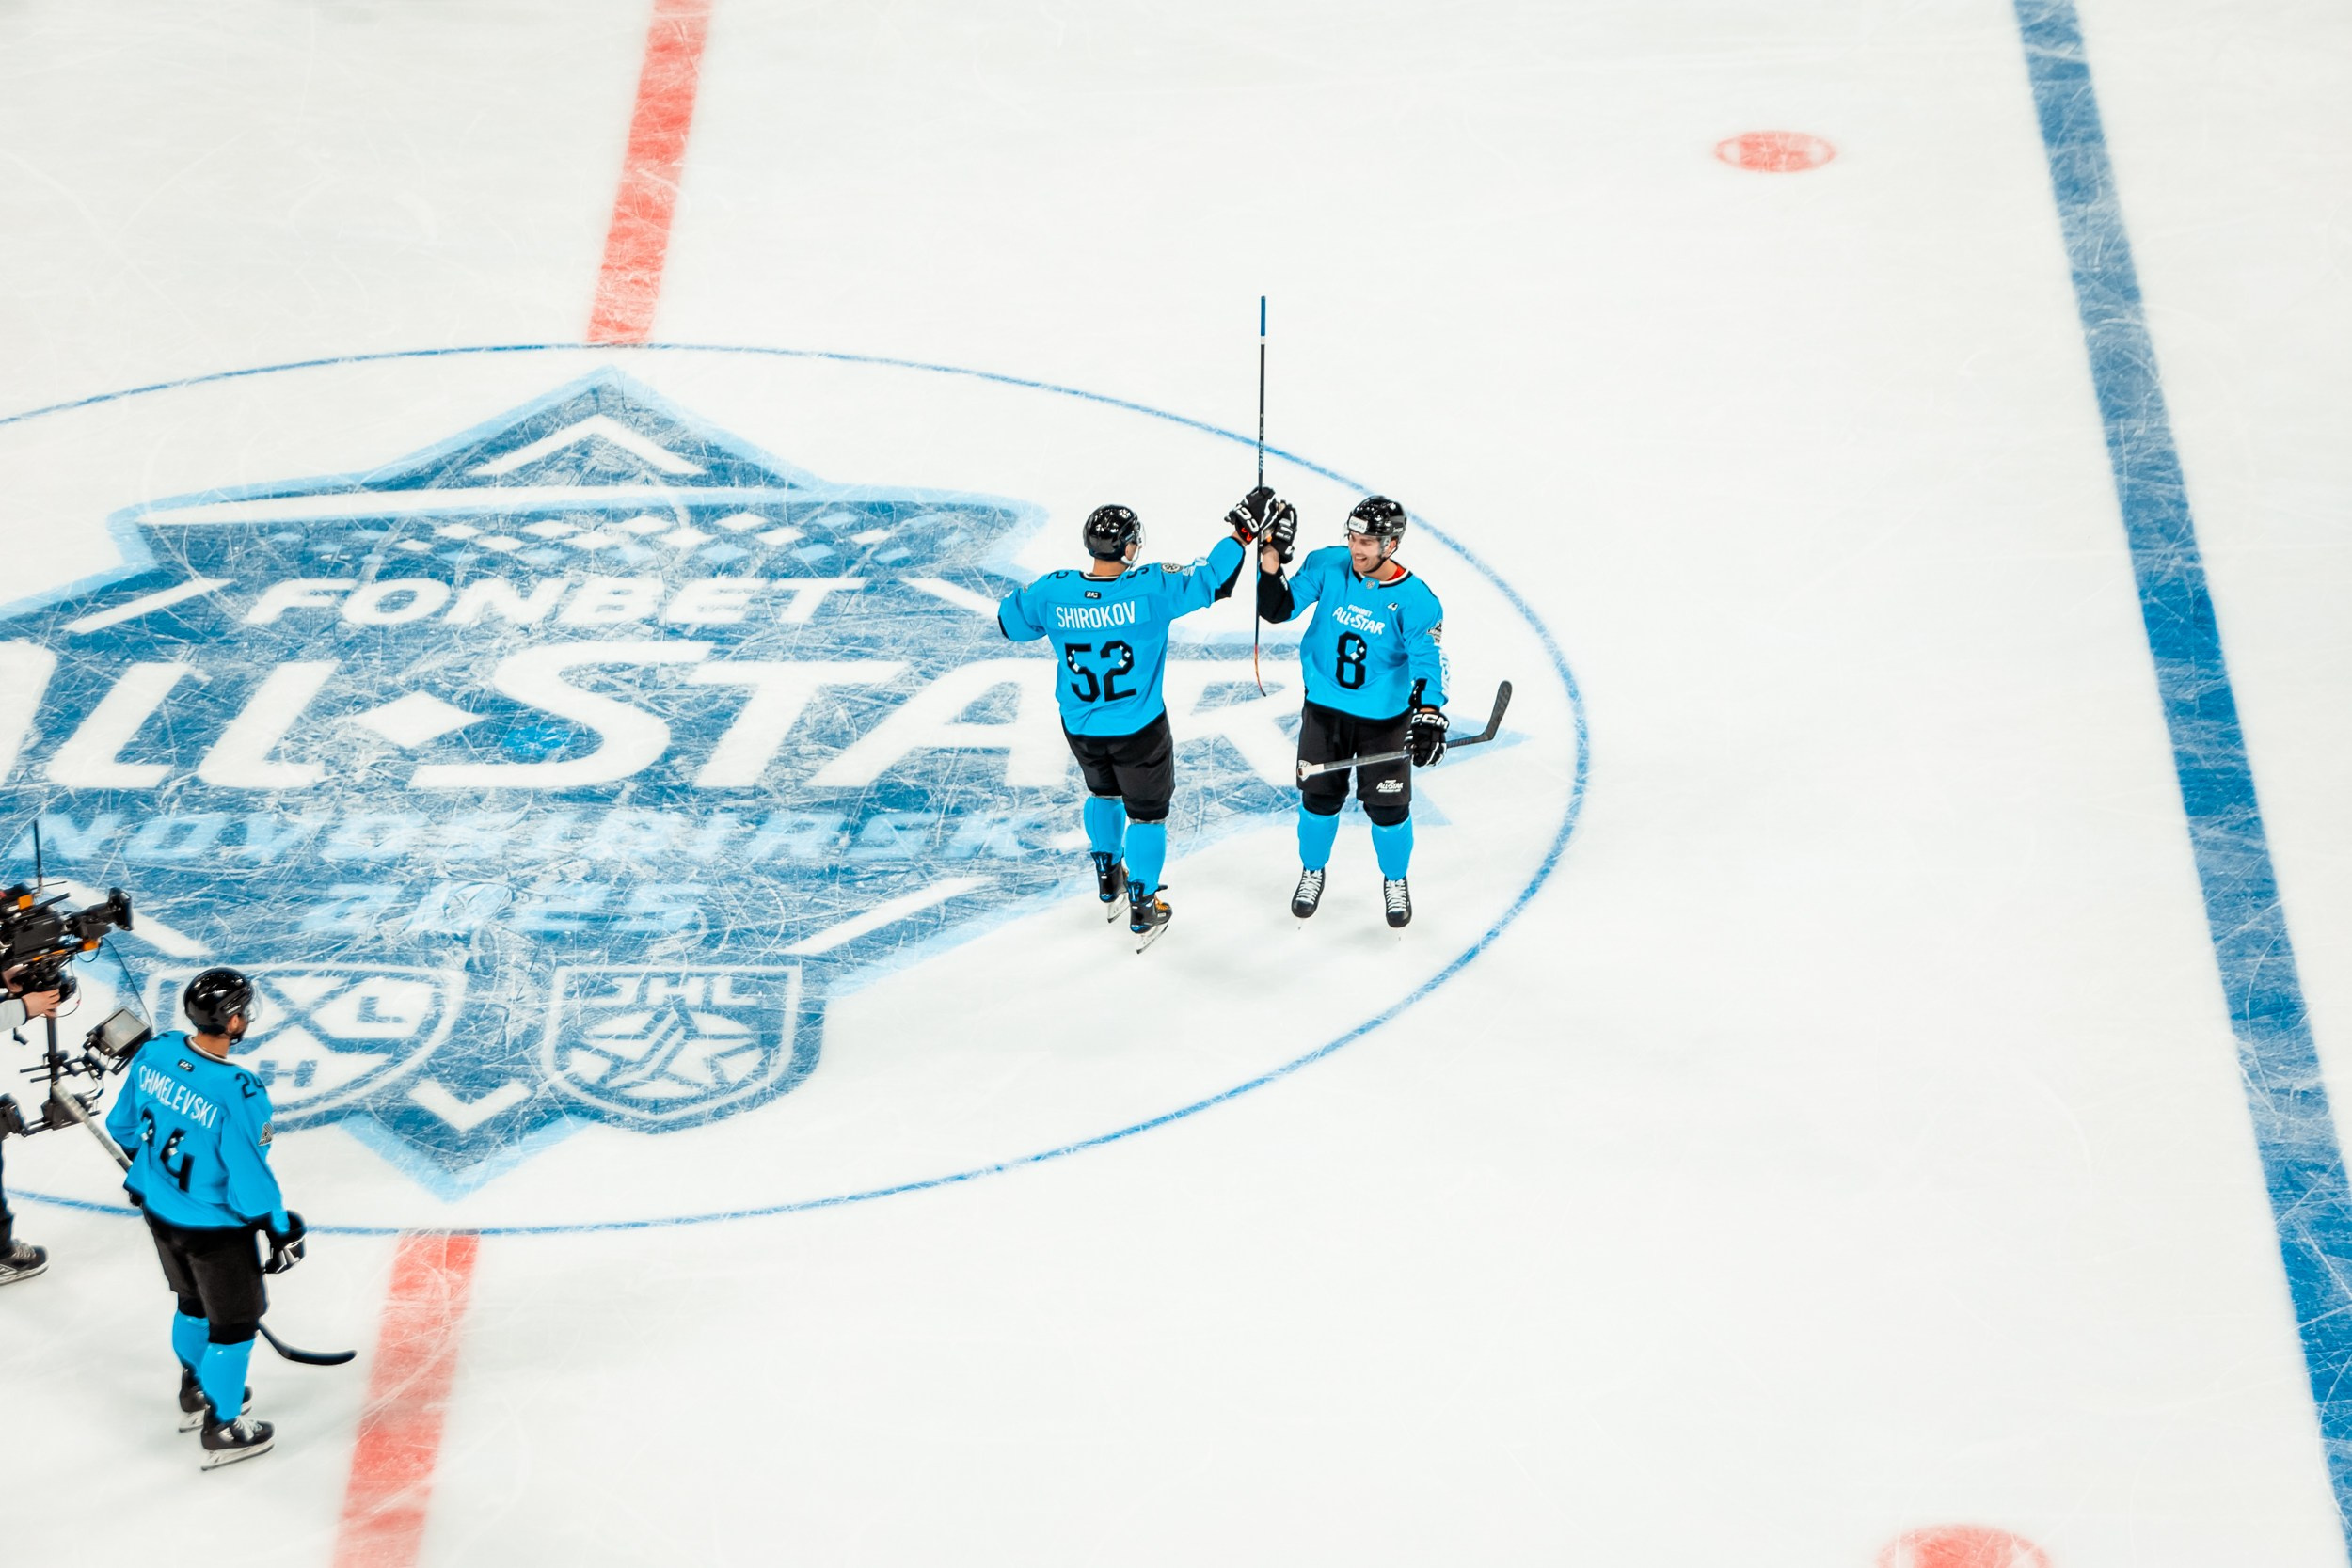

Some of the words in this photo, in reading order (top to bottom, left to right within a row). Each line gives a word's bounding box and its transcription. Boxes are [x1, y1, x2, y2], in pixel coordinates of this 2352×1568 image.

[1232, 504, 1260, 533] CC
[243, 578, 867, 625] FONBET
[1056, 600, 1136, 629] SHIROKOV
[1064, 640, 1137, 703] 52
[1336, 630, 1367, 690] 8
[0, 639, 341, 788] LL
[1411, 713, 1449, 730] CCM
[138, 1065, 218, 1128] CHMELEVSKI
